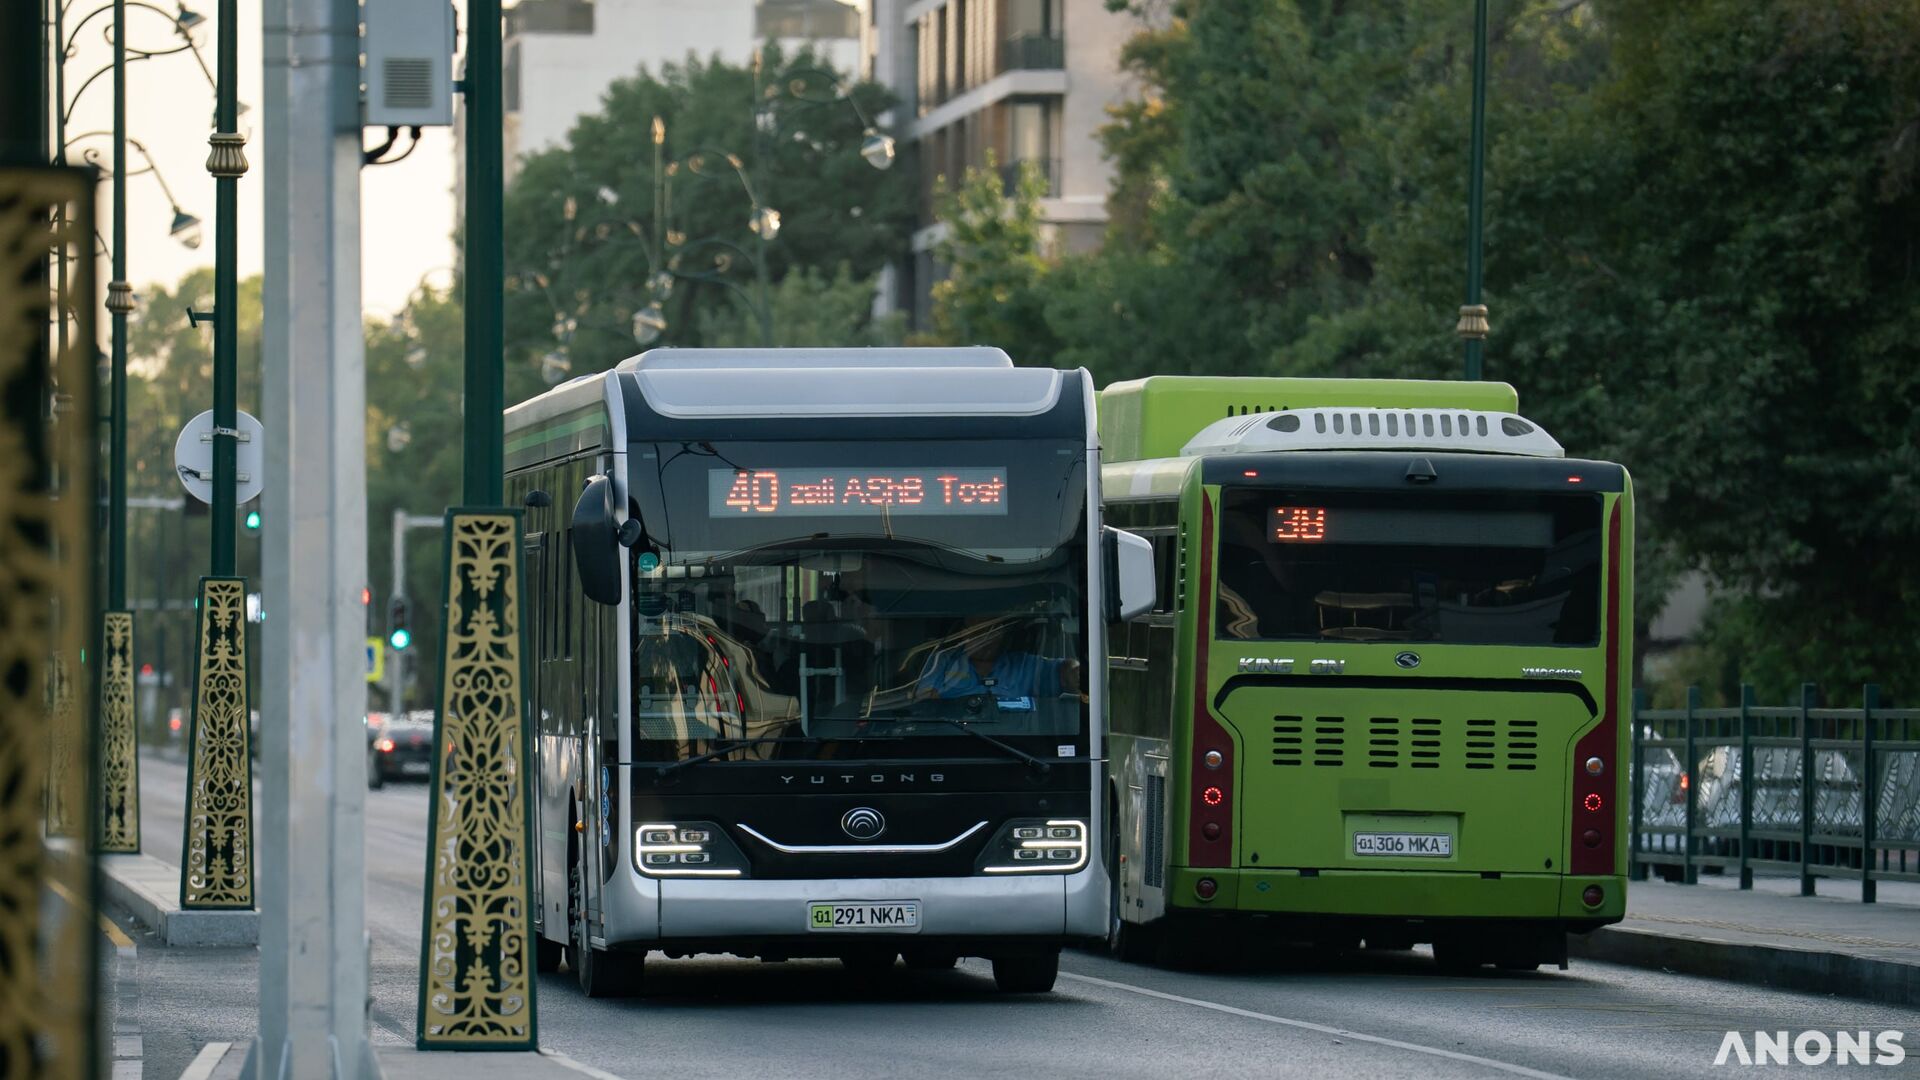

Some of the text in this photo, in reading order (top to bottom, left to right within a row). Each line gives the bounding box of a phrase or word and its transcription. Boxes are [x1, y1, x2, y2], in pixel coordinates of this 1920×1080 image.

[726, 472, 778, 512] 40
[1276, 509, 1324, 539] 38
[781, 774, 945, 784] YUTONG
[1359, 836, 1440, 853] 01 306 MKA
[815, 910, 832, 923] 01
[834, 907, 866, 925] 291
[870, 907, 905, 924] NKA
